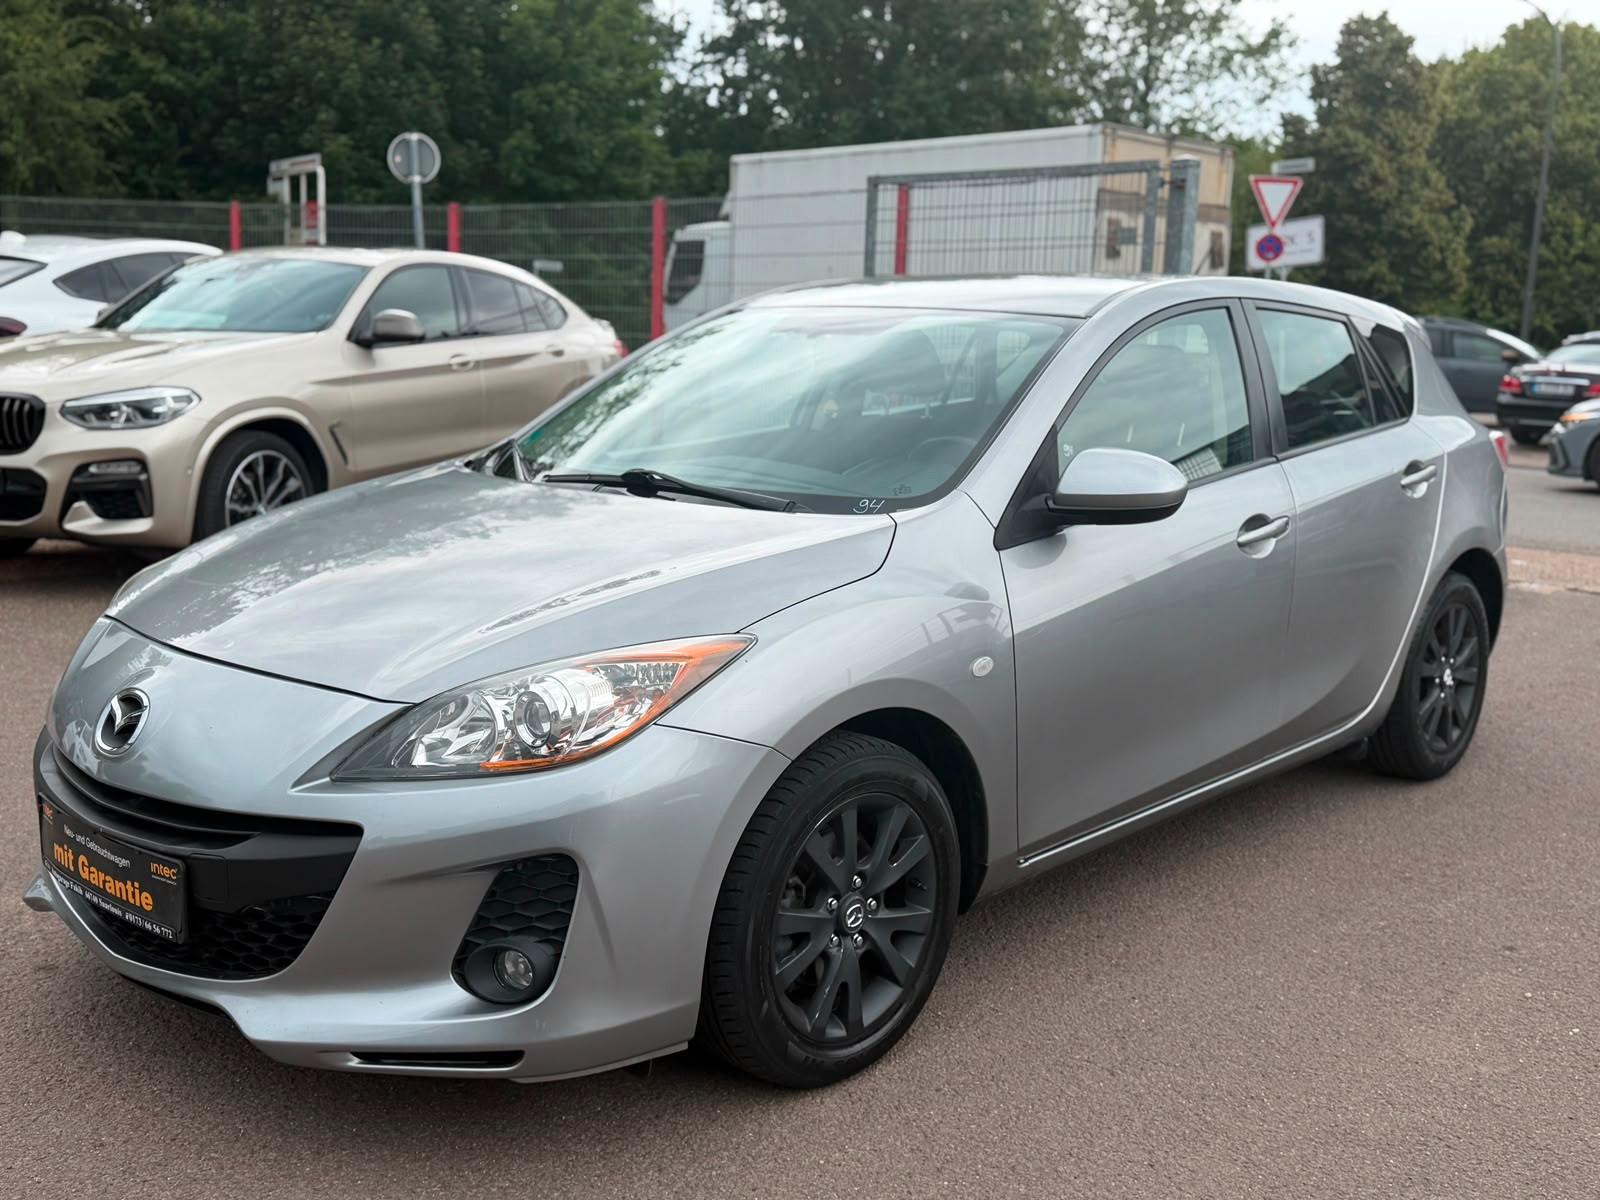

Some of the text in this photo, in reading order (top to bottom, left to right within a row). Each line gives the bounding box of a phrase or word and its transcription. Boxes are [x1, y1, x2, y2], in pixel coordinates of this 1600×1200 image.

[853, 499, 885, 514] 94
[76, 834, 85, 845] und
[86, 837, 130, 868] Gebrauchtwagen
[53, 843, 74, 872] mit
[78, 854, 154, 912] Garantie
